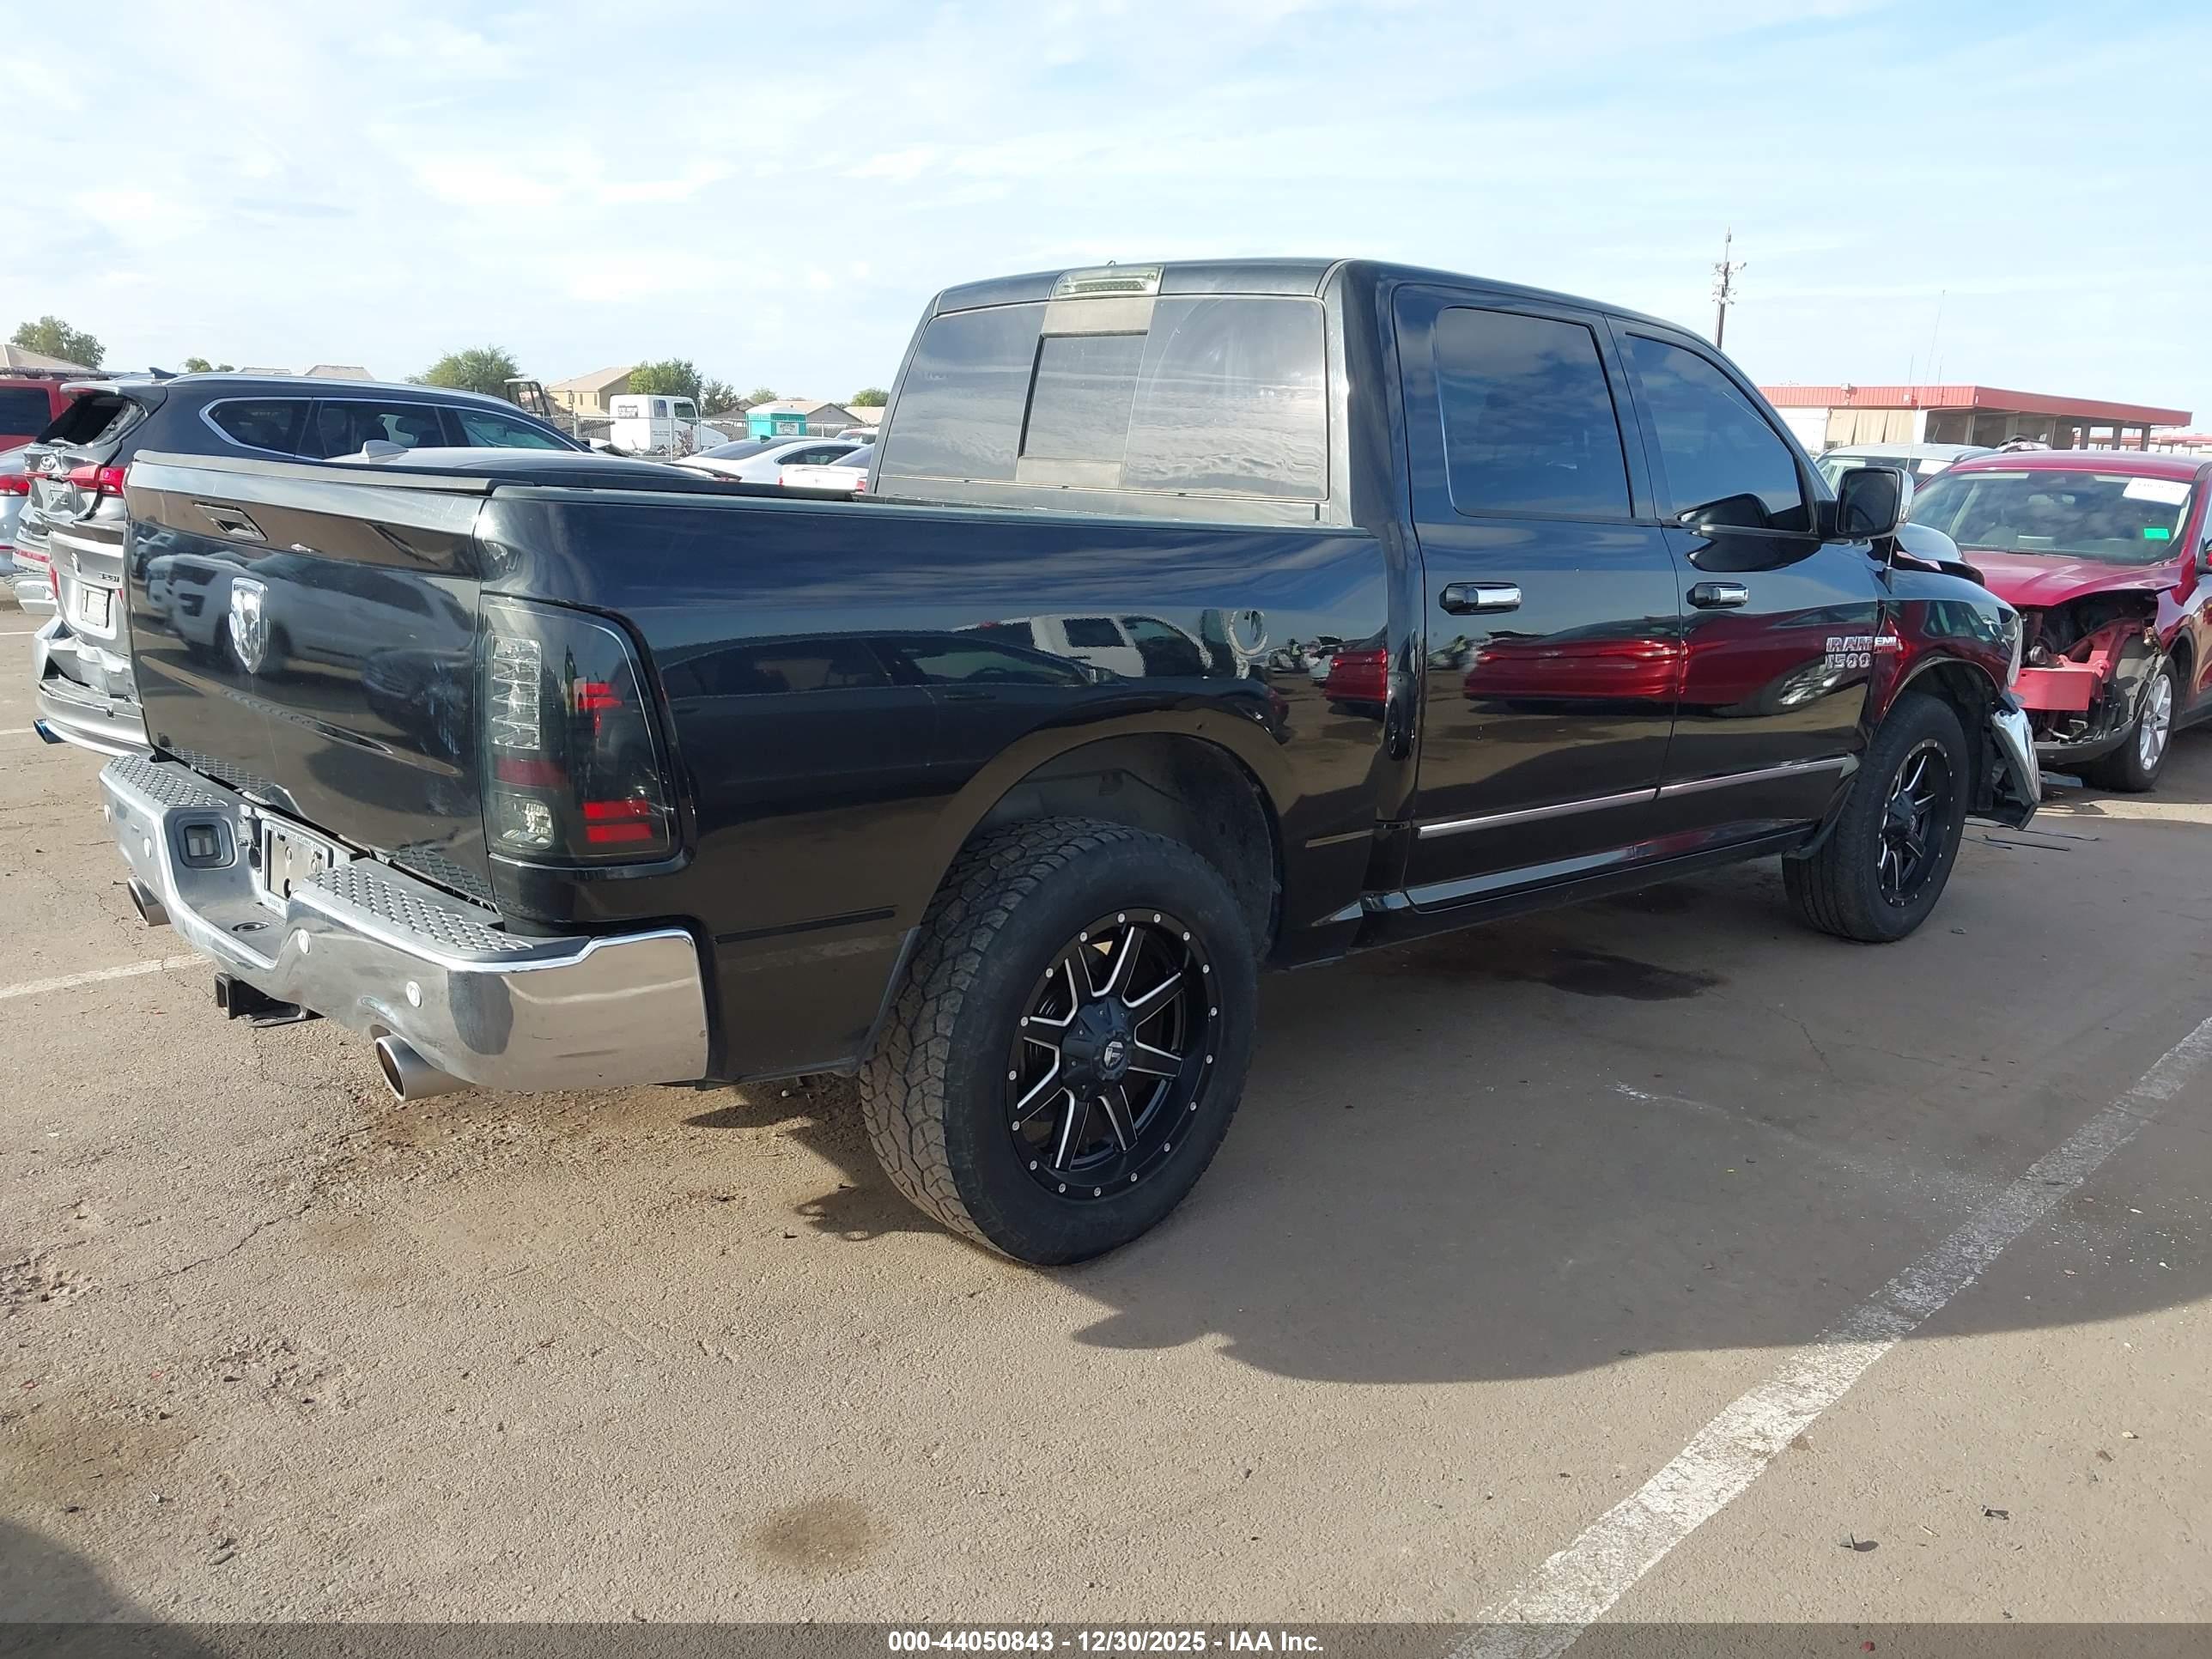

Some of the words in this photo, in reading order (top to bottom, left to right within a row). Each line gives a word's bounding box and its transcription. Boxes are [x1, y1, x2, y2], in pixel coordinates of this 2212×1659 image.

[1826, 636, 1873, 653] RAM
[1874, 636, 1897, 647] EMI
[1826, 653, 1871, 670] 1500
